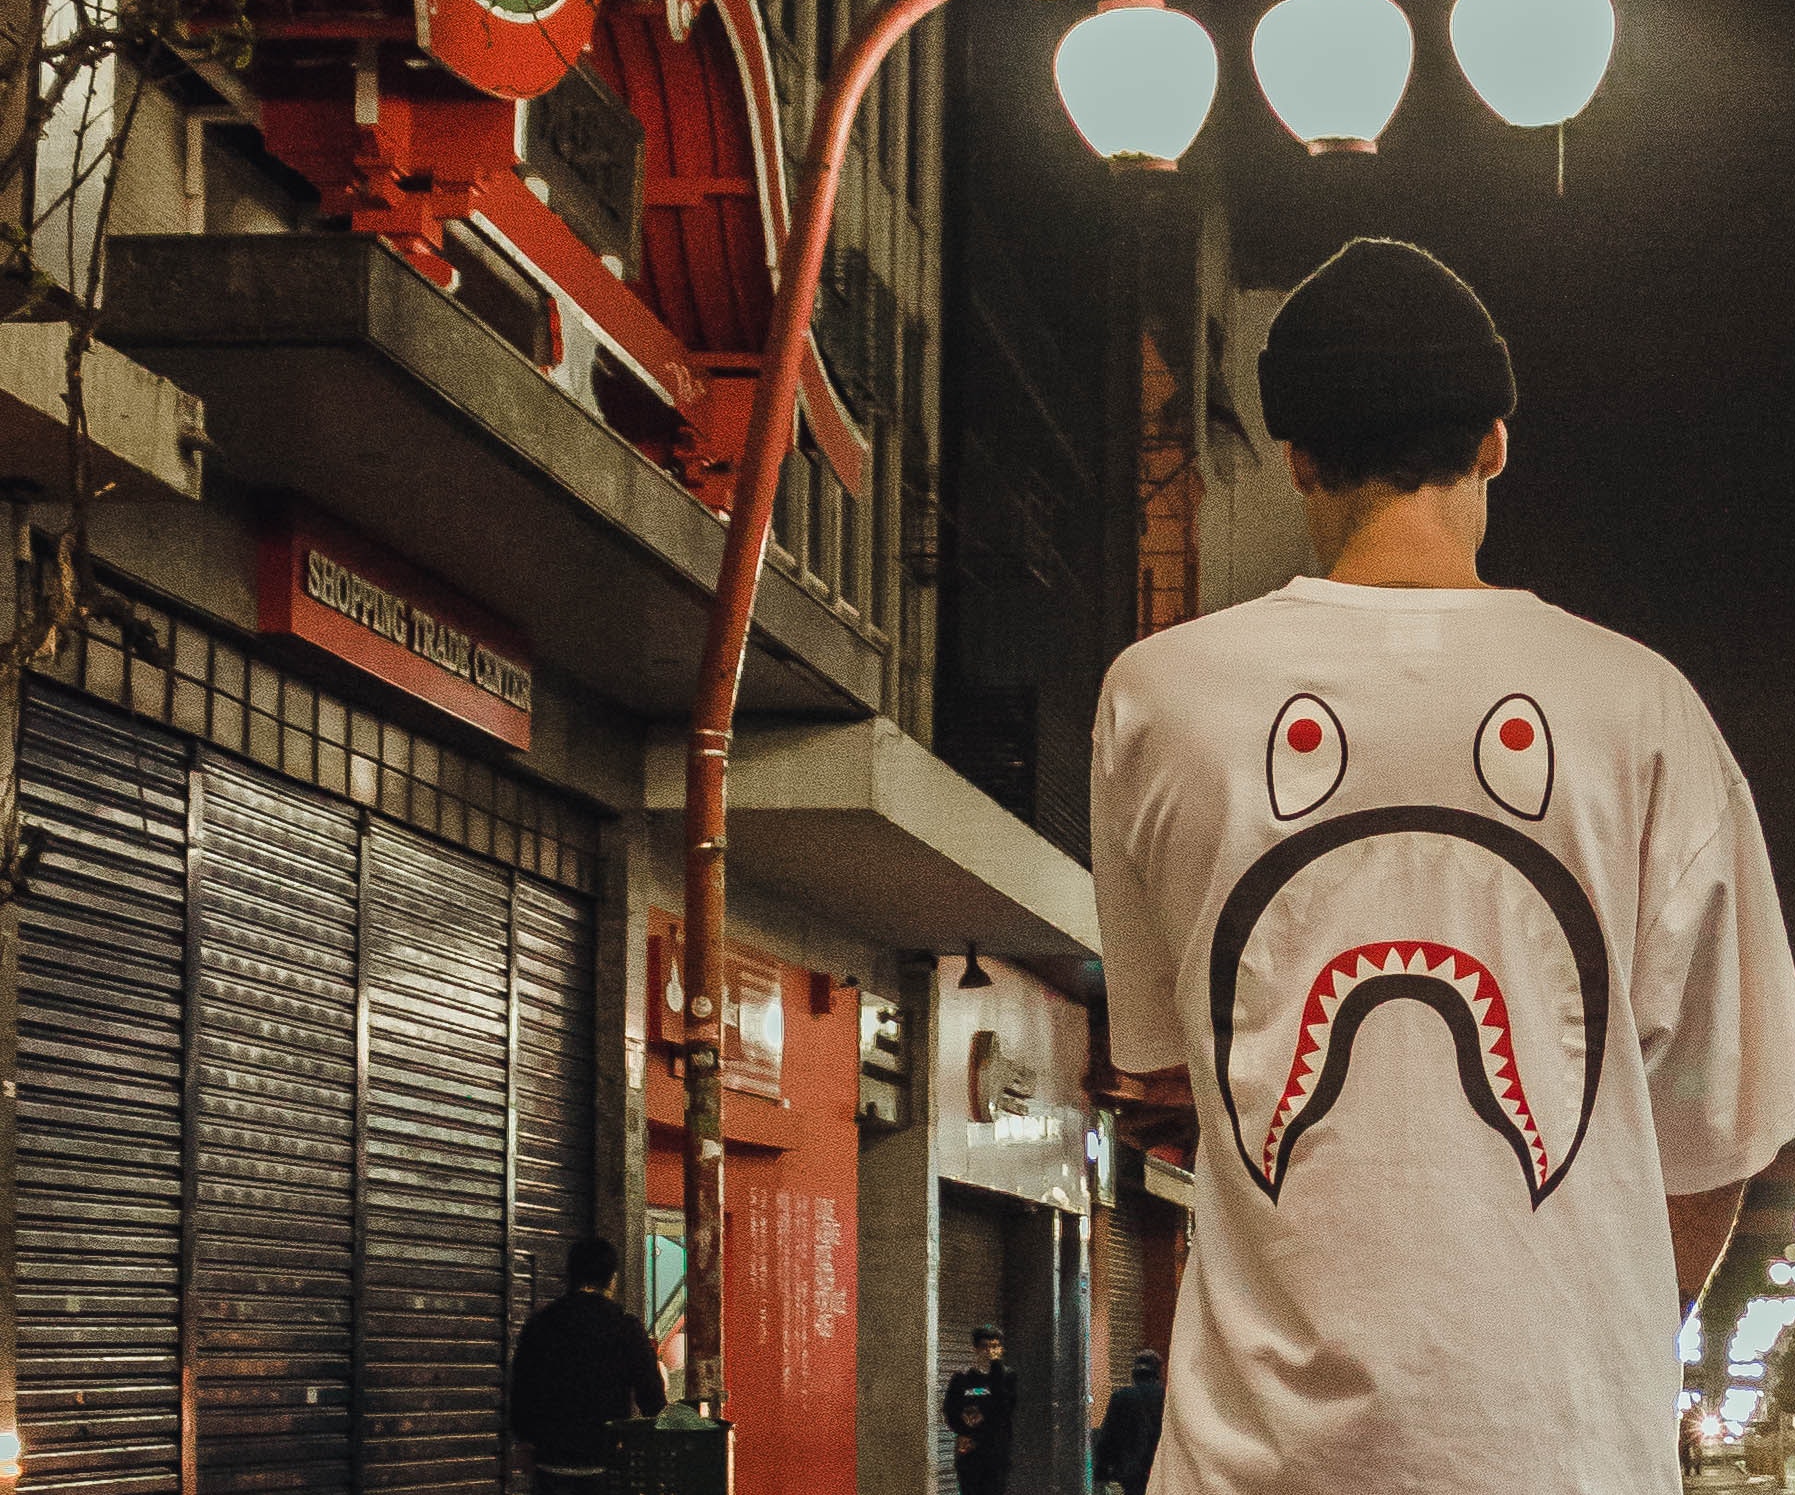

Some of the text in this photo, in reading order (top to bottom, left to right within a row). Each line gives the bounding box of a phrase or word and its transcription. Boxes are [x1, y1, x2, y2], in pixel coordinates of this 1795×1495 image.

[307, 549, 533, 713] SHOPPING TRADE CENTER
